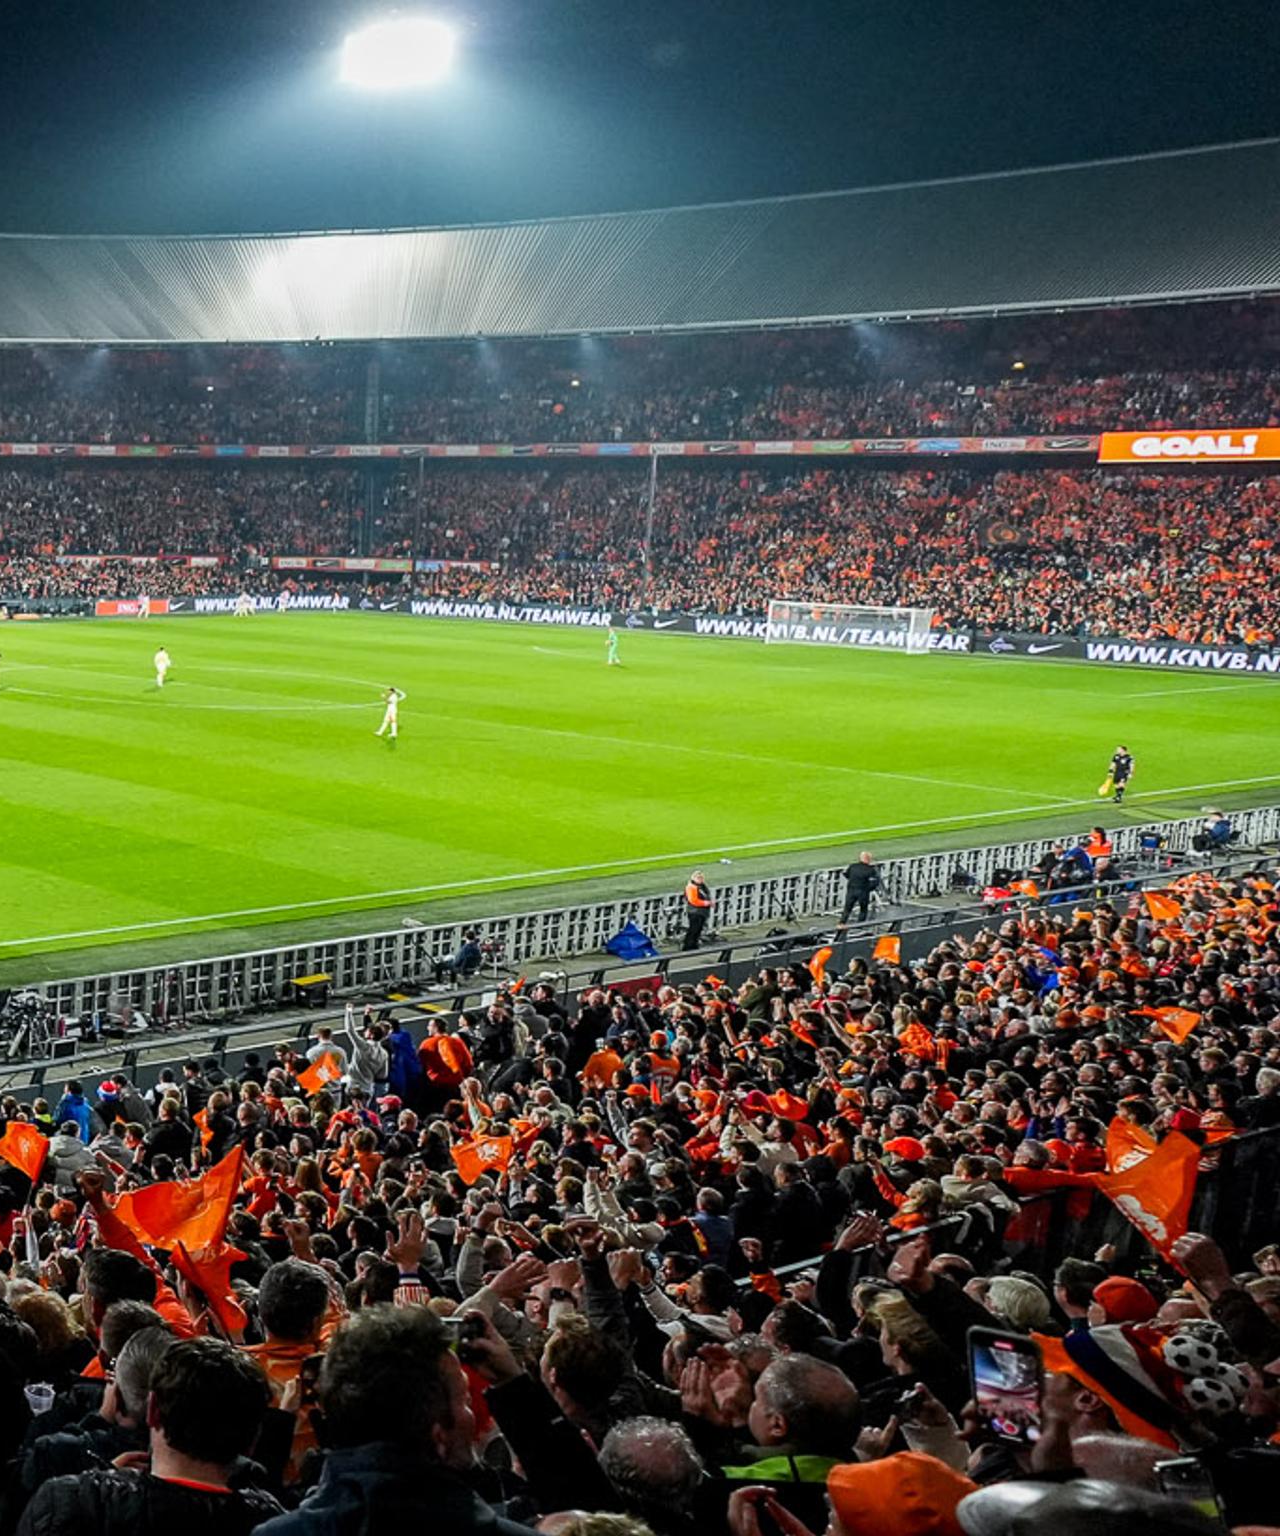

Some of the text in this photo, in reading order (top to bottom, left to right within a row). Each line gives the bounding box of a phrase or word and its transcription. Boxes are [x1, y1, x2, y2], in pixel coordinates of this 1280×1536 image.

[1131, 434, 1259, 457] GOAL!
[410, 600, 613, 627] WWW.KNVB.NL/TEAMWEAR
[694, 618, 970, 652] WWW.KNVB.NL/TEAMWEAR
[1086, 643, 1280, 672] WWW.KNVB.N
